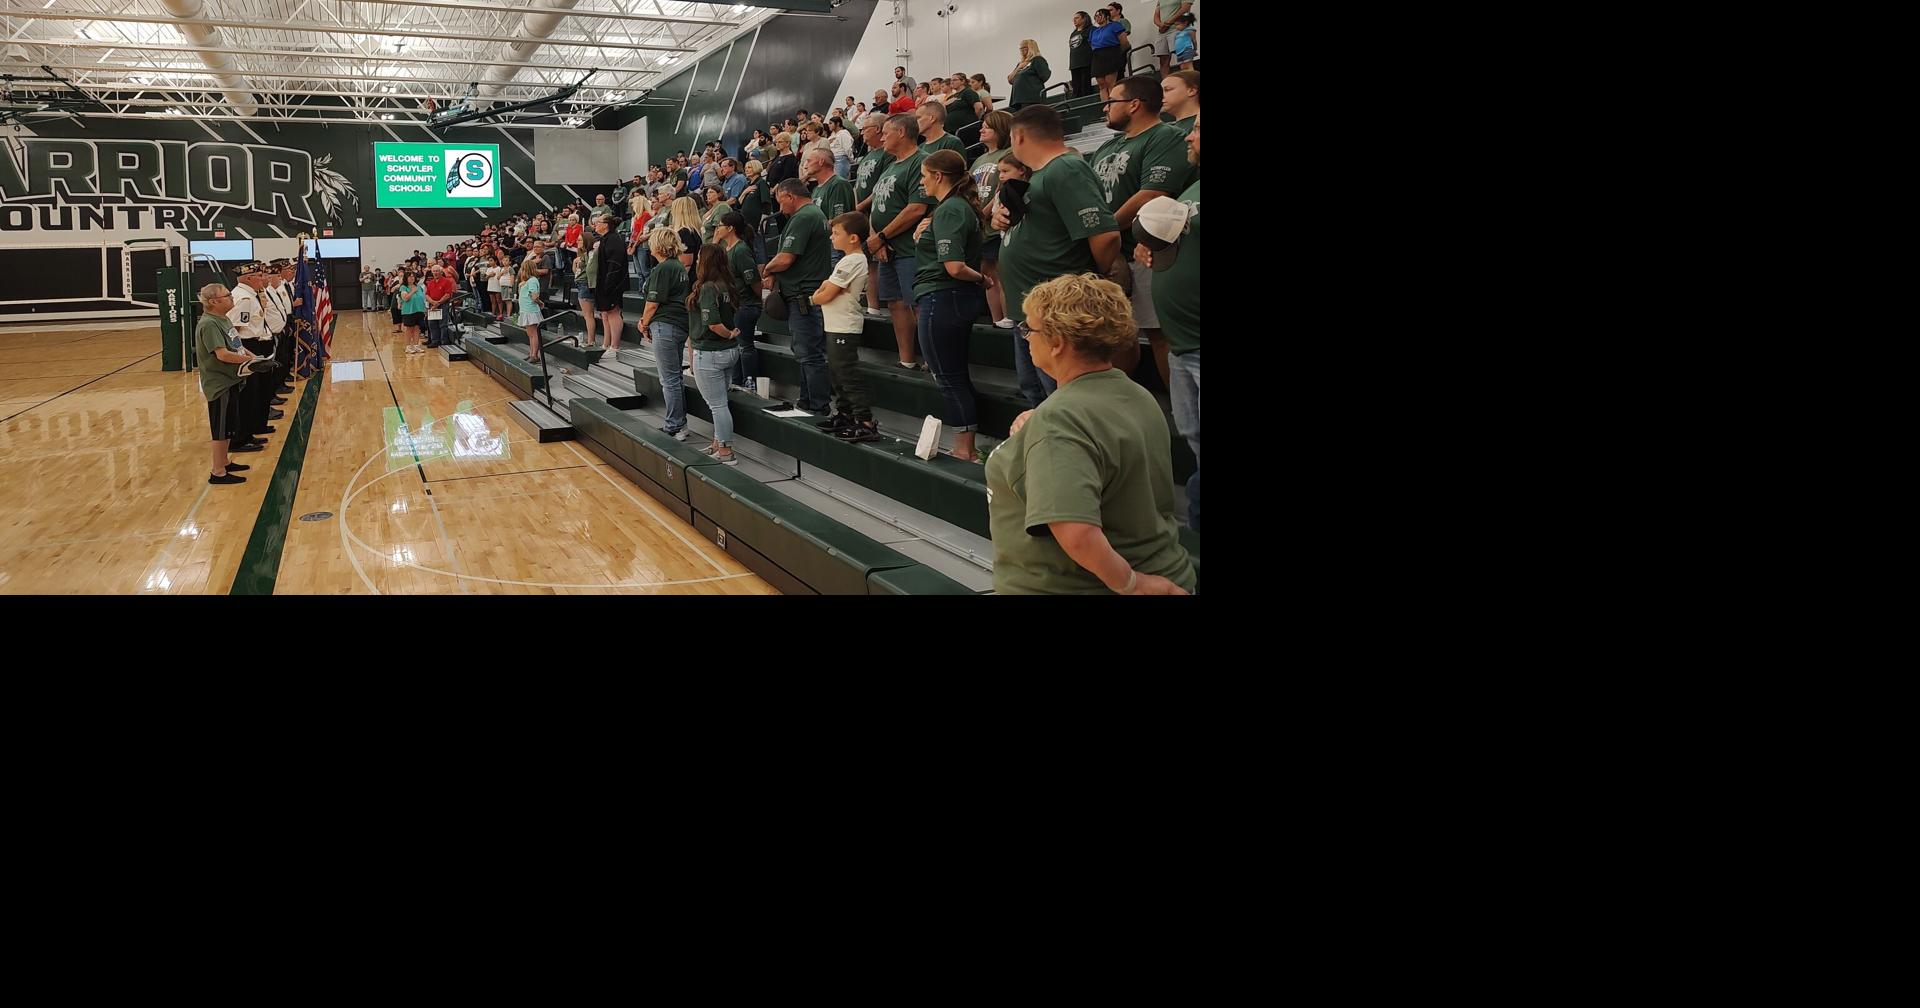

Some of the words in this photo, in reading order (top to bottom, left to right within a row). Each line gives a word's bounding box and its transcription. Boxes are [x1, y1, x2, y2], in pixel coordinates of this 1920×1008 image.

[379, 154, 424, 163] WELCOME
[428, 155, 440, 163] TO
[386, 165, 433, 173] SCHUYLER
[466, 160, 484, 180] S
[388, 184, 433, 192] SCHOOLS!
[0, 204, 222, 231] OUNTRY
[166, 288, 177, 323] WARRIORS
